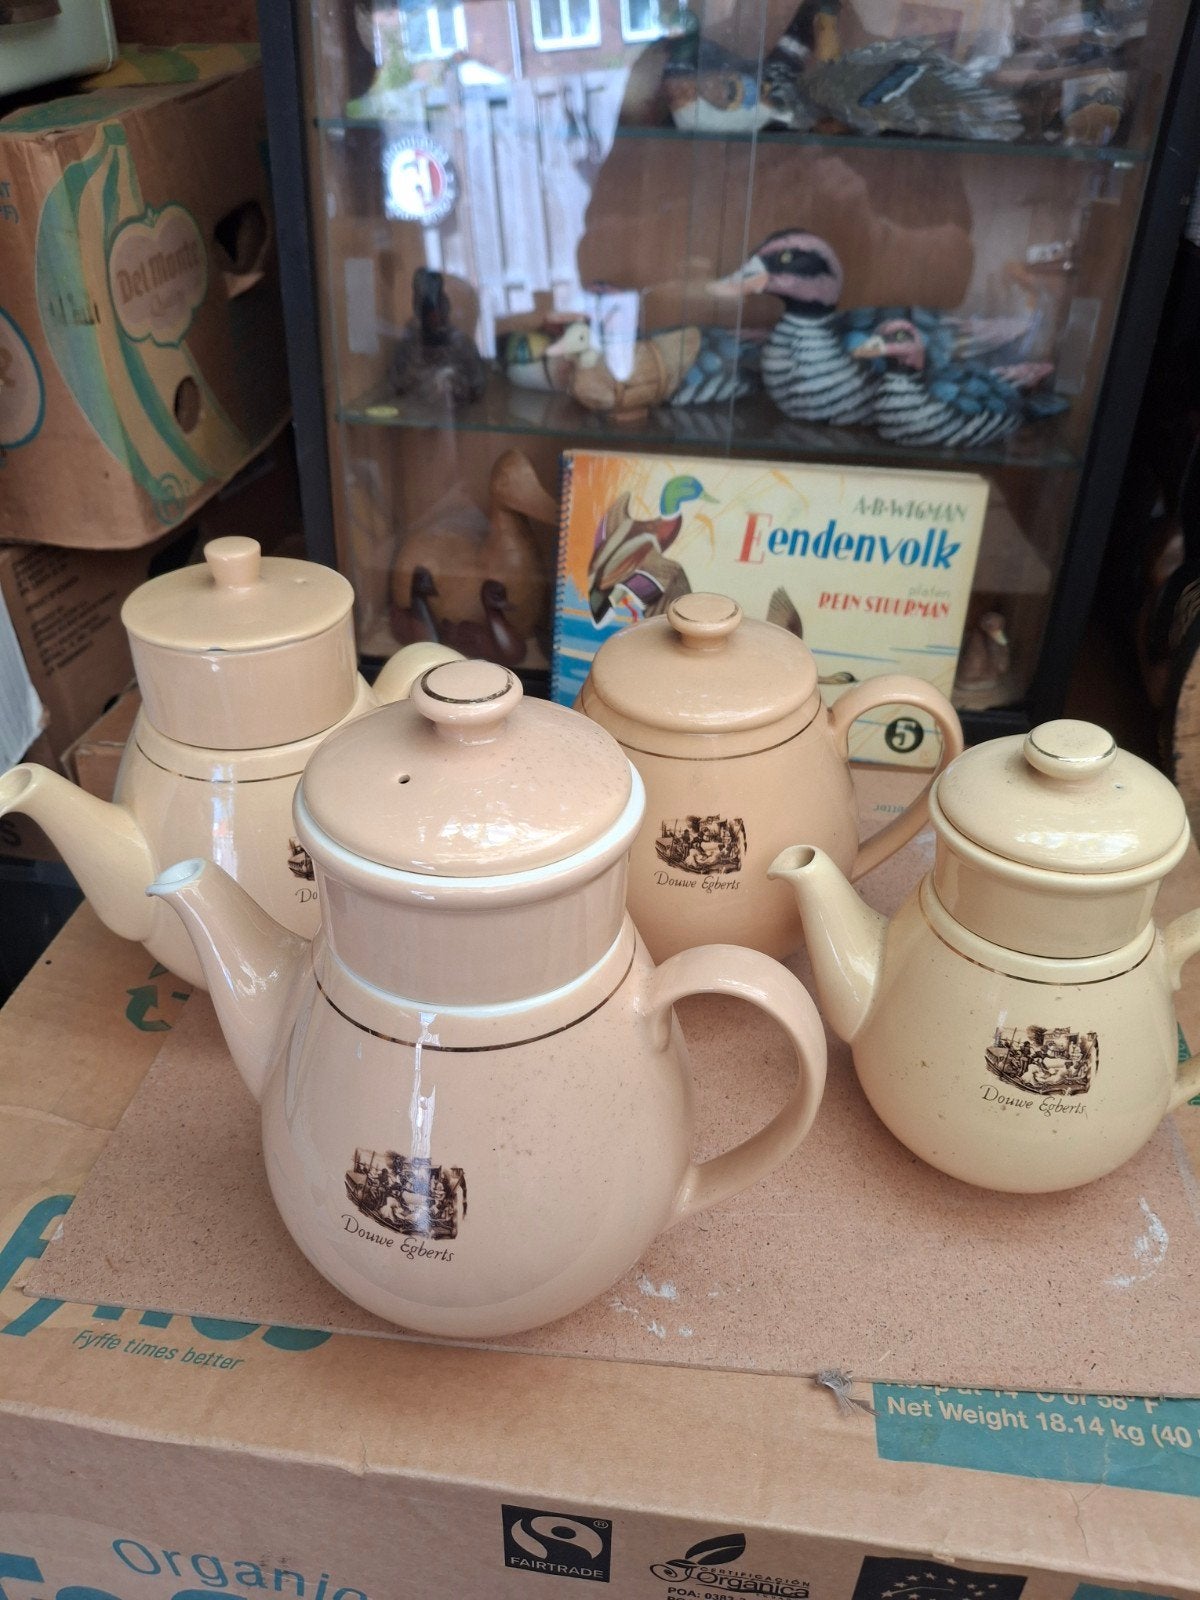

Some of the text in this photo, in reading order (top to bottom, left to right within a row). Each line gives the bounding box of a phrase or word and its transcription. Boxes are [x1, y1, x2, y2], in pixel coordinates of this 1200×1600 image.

[736, 511, 962, 570] Eendenvolk
[818, 591, 861, 610] REIN
[891, 719, 917, 749] 5
[653, 870, 741, 894] Douwe Egberts
[979, 1083, 1088, 1117] Douwe Egberts
[341, 1213, 456, 1262] Douwe Egberts
[72, 1329, 245, 1370] Fyffe times better
[887, 1396, 933, 1418] Net
[938, 1400, 1030, 1431] Weight
[1035, 1411, 1105, 1436] 18.14
[1110, 1418, 1146, 1447] kg
[1151, 1424, 1193, 1449] (40
[509, 1556, 604, 1579] FAIRTRADE
[667, 1586, 701, 1598] POA:
